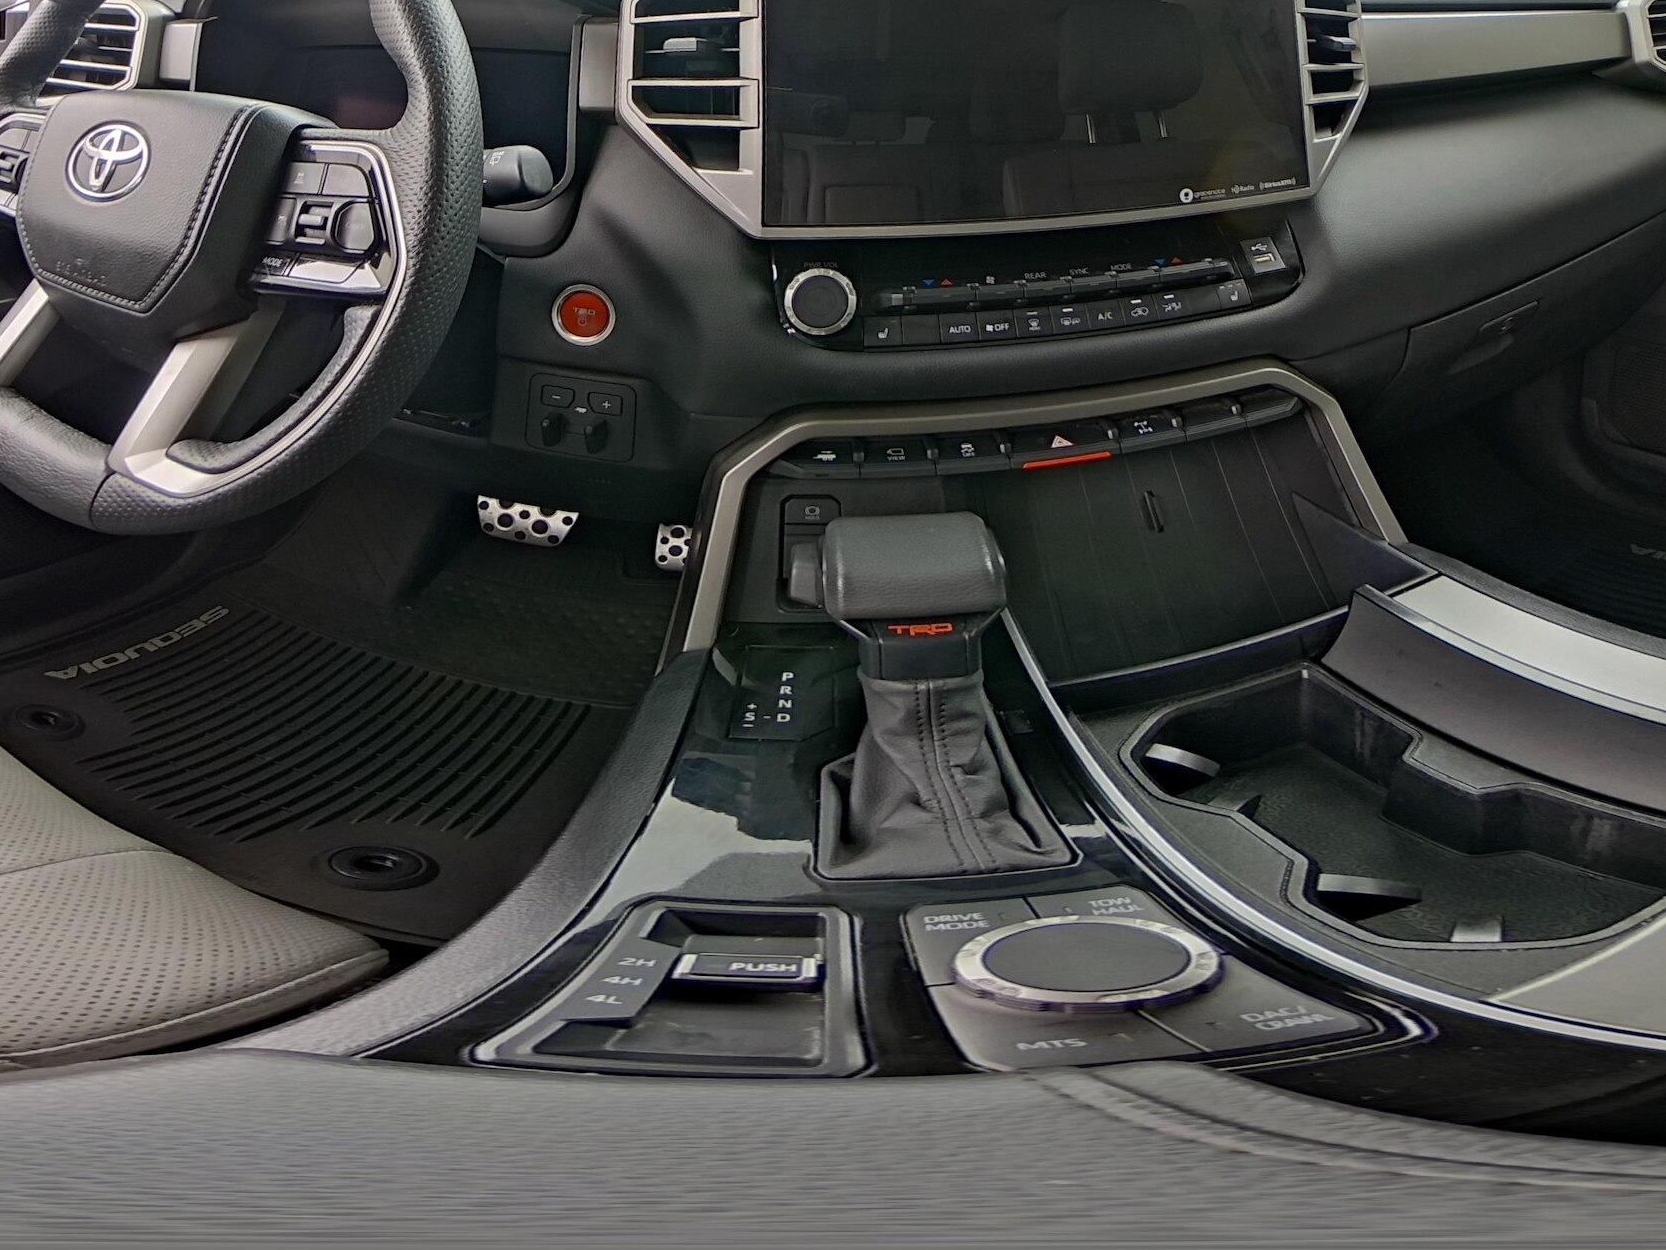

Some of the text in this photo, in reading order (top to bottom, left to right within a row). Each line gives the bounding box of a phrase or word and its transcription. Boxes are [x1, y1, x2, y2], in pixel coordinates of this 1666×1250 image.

[262, 256, 283, 267] MODE
[1069, 267, 1089, 276] SYNC
[1110, 263, 1133, 271] MODE
[1024, 271, 1047, 280] REAR
[1097, 311, 1113, 321] A/C
[948, 325, 971, 334] AUTO
[994, 323, 1010, 332] OFF
[887, 622, 954, 637] TRD
[44, 605, 230, 680] SEQUOIA
[781, 672, 794, 682] P
[779, 685, 793, 695] R
[778, 699, 793, 709] N
[744, 712, 756, 721] S
[776, 713, 791, 723] D
[1088, 896, 1132, 908] TOW
[1092, 904, 1145, 916] HAUL
[923, 911, 985, 924] DRIVE
[924, 919, 991, 931] MODE
[616, 957, 657, 967] 2H
[729, 962, 797, 973] PUSH
[602, 975, 644, 986] 4H
[586, 994, 623, 1005] 4L
[1254, 1012, 1335, 1031] CRAWL
[1015, 1038, 1089, 1051] MTS
